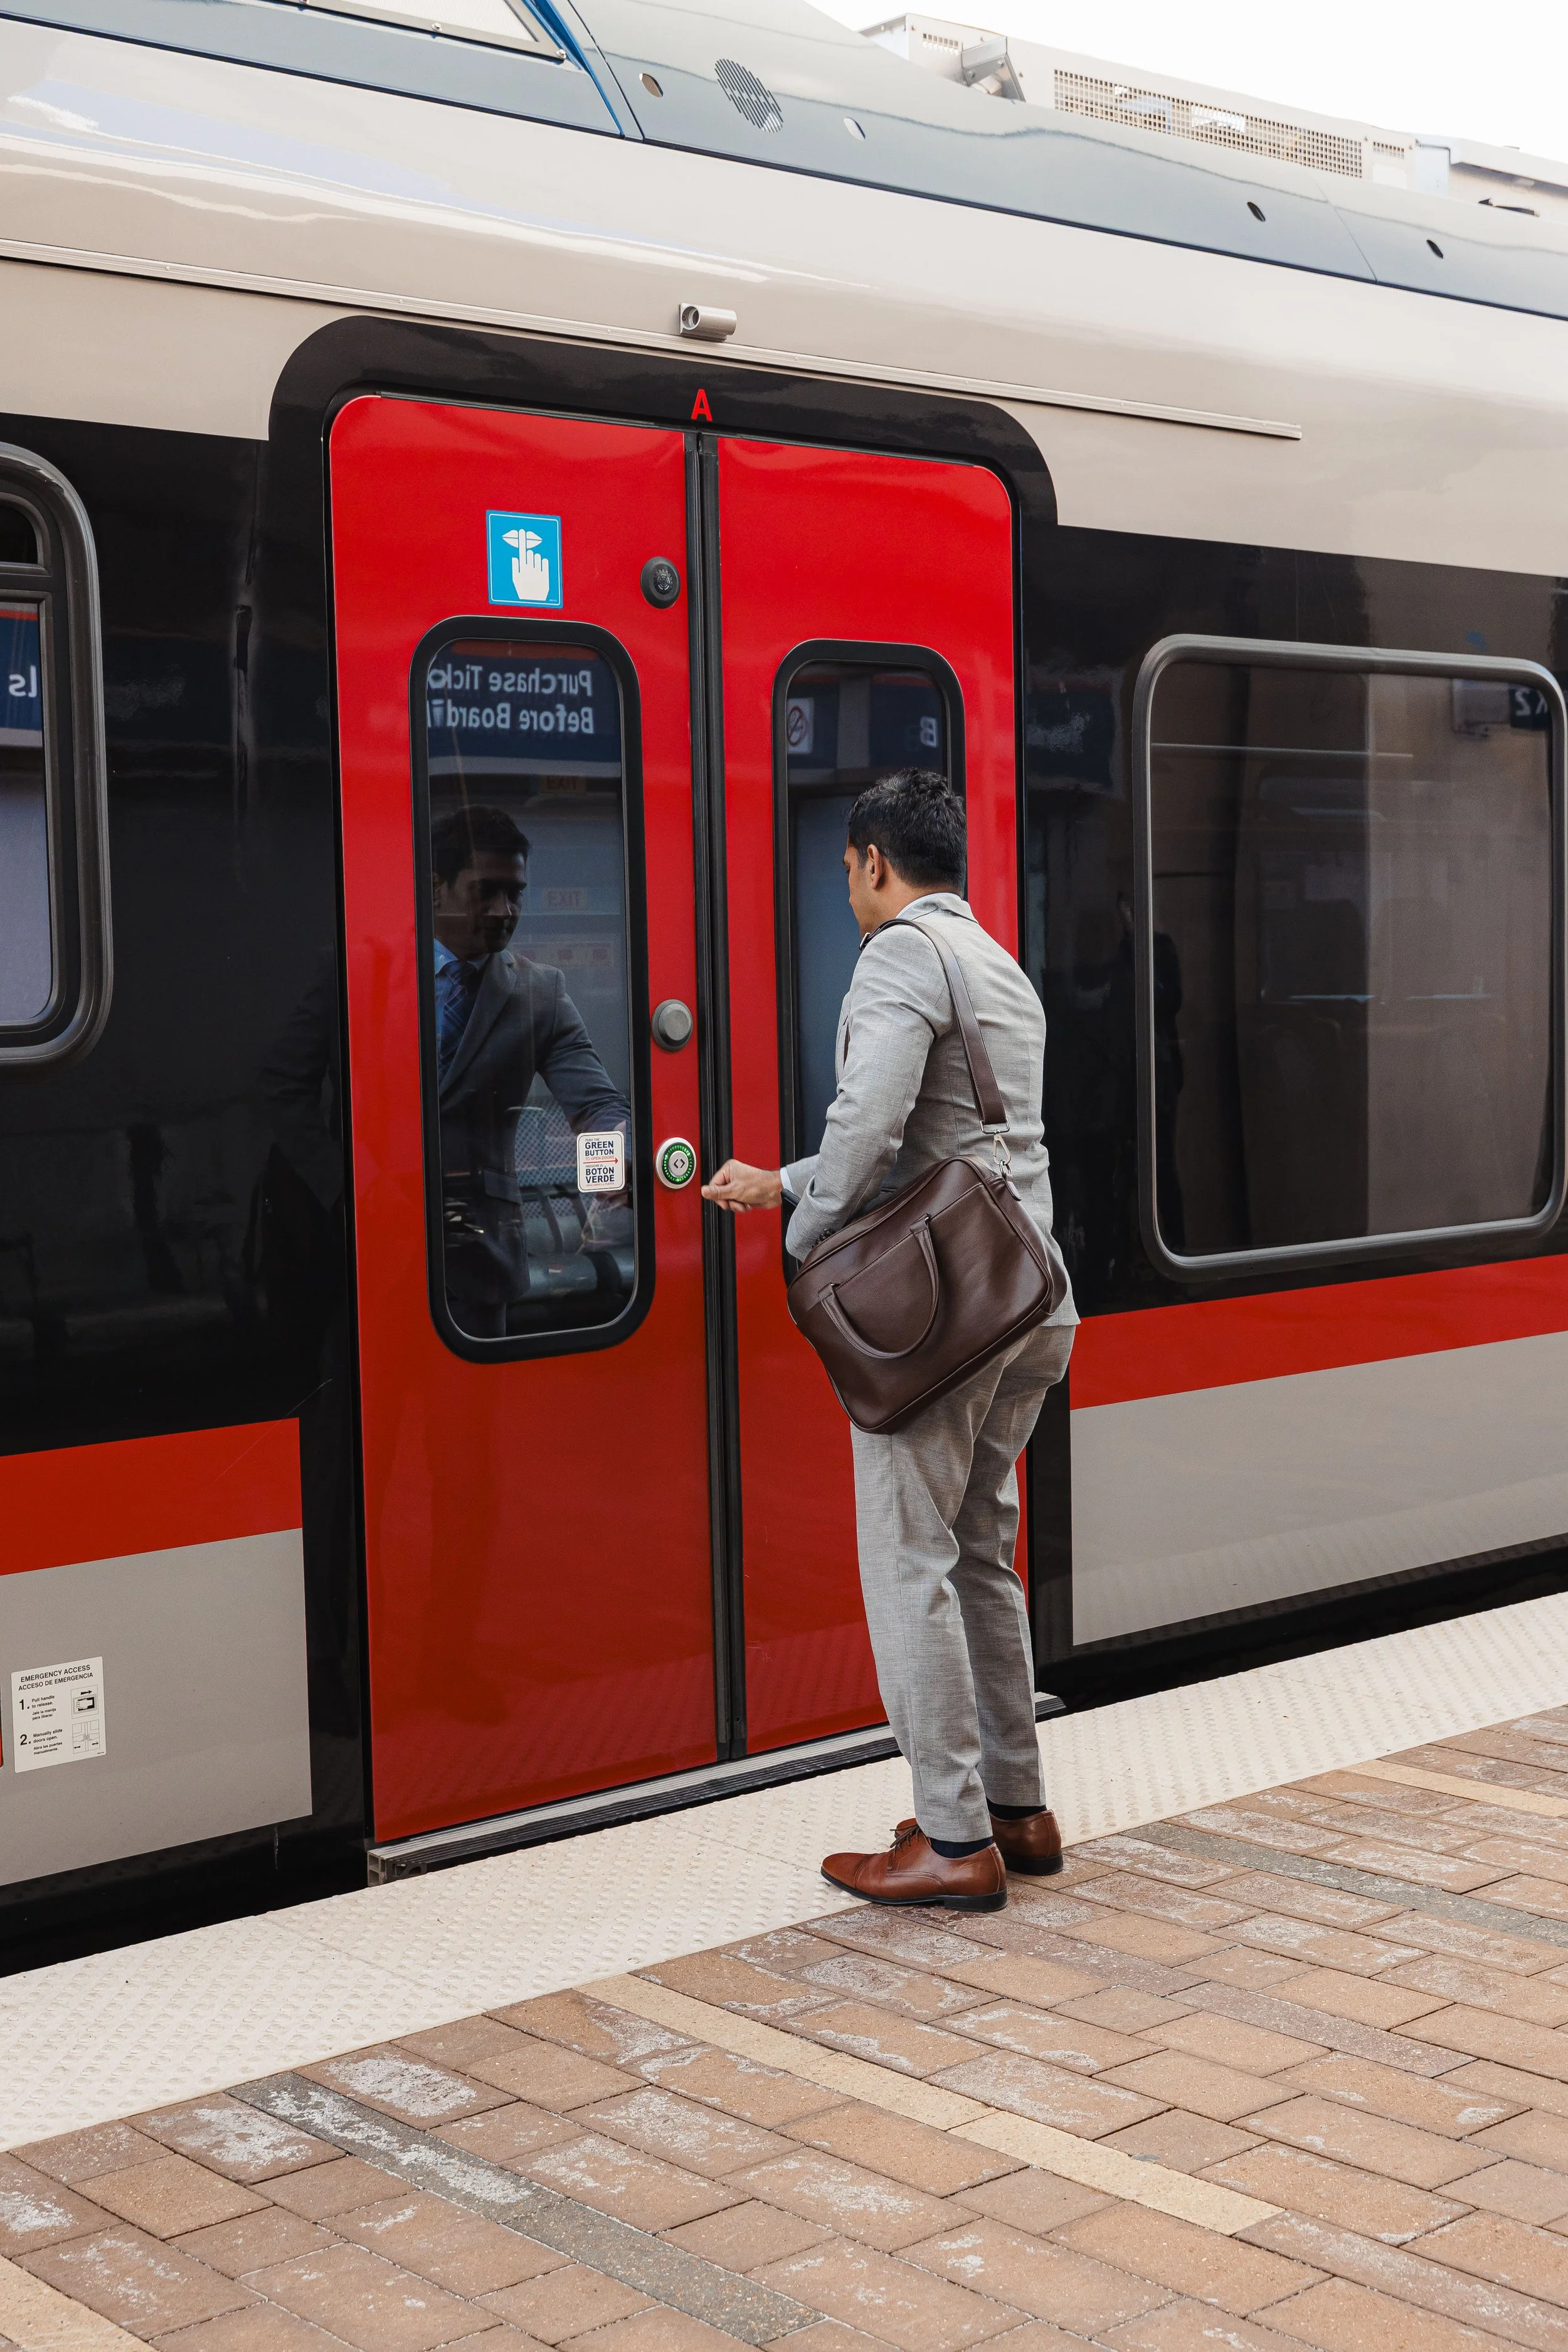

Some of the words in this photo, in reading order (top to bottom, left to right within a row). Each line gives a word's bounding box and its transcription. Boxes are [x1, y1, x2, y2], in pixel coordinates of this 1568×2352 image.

[691, 389, 712, 421] A
[585, 1141, 613, 1149] GREEN
[585, 1148, 614, 1157] BUTTON
[586, 1165, 614, 1175] BOTÓN
[585, 1175, 615, 1184] VERDE
[21, 1670, 62, 1683] EMERGENCY
[63, 1665, 90, 1675] ACCESS
[18, 1682, 43, 1691] ACCESO
[55, 1672, 93, 1684] EMERGENCIA
[19, 1699, 29, 1710] 1.
[19, 1734, 31, 1745] 2.
